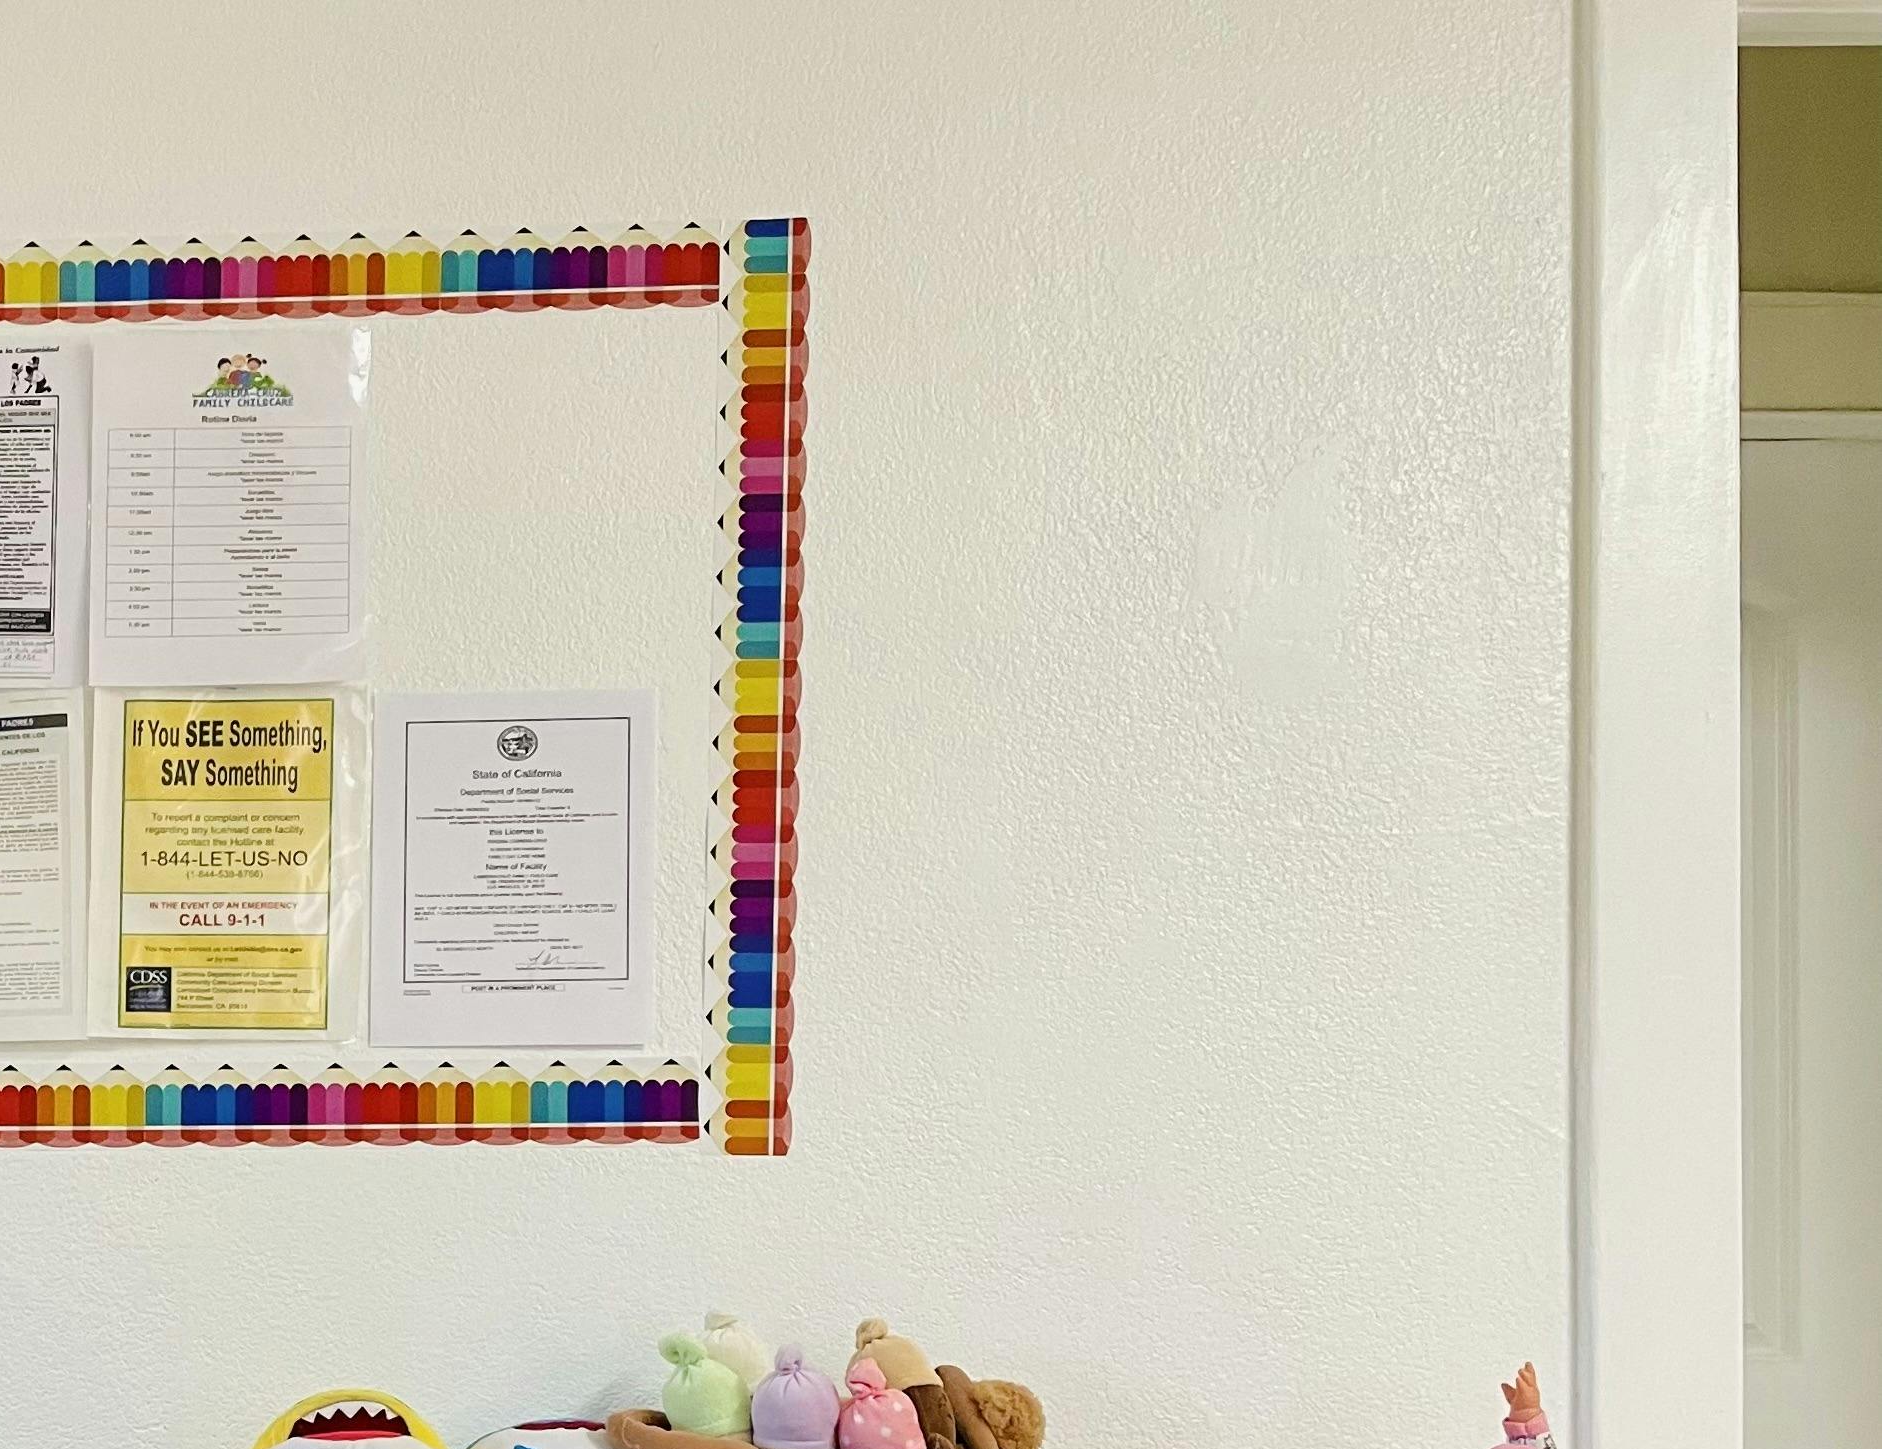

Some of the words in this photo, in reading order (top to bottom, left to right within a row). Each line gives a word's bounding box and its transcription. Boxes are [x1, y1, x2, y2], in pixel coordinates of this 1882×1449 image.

[192, 399, 231, 408] FAMILY
[238, 397, 294, 407] CHILDCARE
[2, 718, 34, 728] PADRES
[132, 719, 144, 747] If
[148, 719, 180, 747] You
[185, 719, 224, 747] SEE
[229, 719, 327, 753] Something,
[161, 759, 200, 786] SAY
[206, 758, 298, 793] Something
[472, 770, 499, 779] State
[501, 770, 512, 779] of
[514, 769, 562, 779] California
[460, 788, 504, 796] Department
[506, 788, 515, 796] of
[542, 787, 574, 795] Services
[152, 813, 163, 822] To
[165, 814, 192, 823] report
[204, 813, 248, 823] complaint
[263, 814, 300, 822] concern
[145, 826, 189, 835] regarding
[191, 827, 208, 835] any
[211, 825, 249, 834] licensed
[275, 825, 304, 835] facility
[177, 838, 210, 846] contact
[212, 838, 228, 846] the
[230, 838, 262, 846] Hotline
[265, 838, 275, 846] at
[141, 850, 308, 867] 1-844-LET-US-NO
[510, 863, 518, 871] of
[149, 901, 159, 909] IN
[160, 901, 178, 909] THE
[180, 901, 210, 909] EVENT
[212, 901, 224, 909] OF
[226, 901, 239, 909] AN
[241, 901, 298, 909] EMERGENCY
[179, 913, 223, 927] CALL
[227, 913, 266, 927] 9-1-1
[130, 970, 168, 984] CDSS
